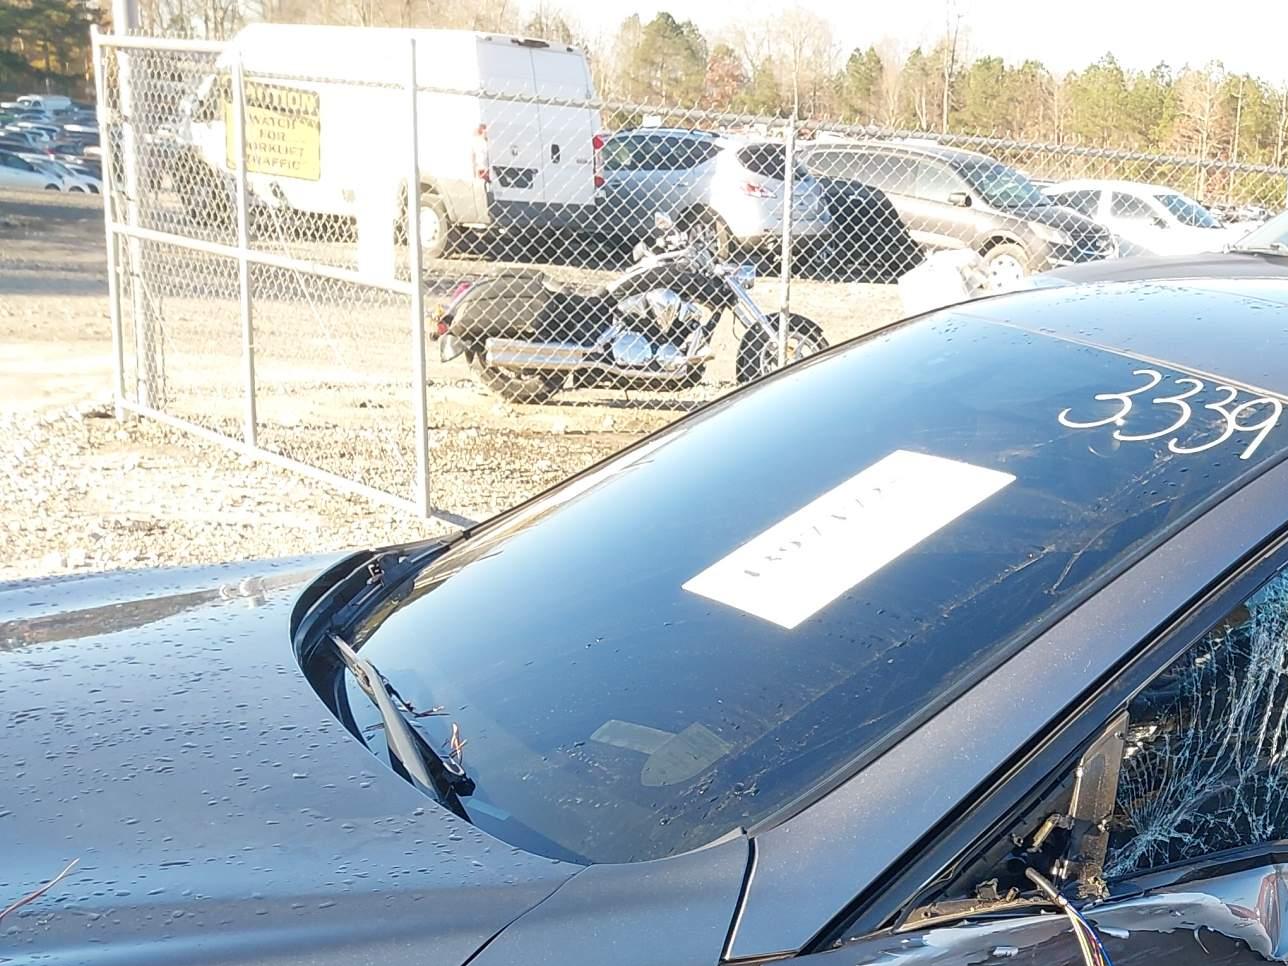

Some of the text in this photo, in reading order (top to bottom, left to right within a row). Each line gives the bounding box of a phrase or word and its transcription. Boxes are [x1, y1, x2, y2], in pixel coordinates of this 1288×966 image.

[244, 84, 317, 111] AUTION
[249, 114, 296, 129] WATCH
[259, 129, 286, 141] FOR
[246, 142, 304, 156] ORKLIFT
[1058, 369, 1282, 459] 3339
